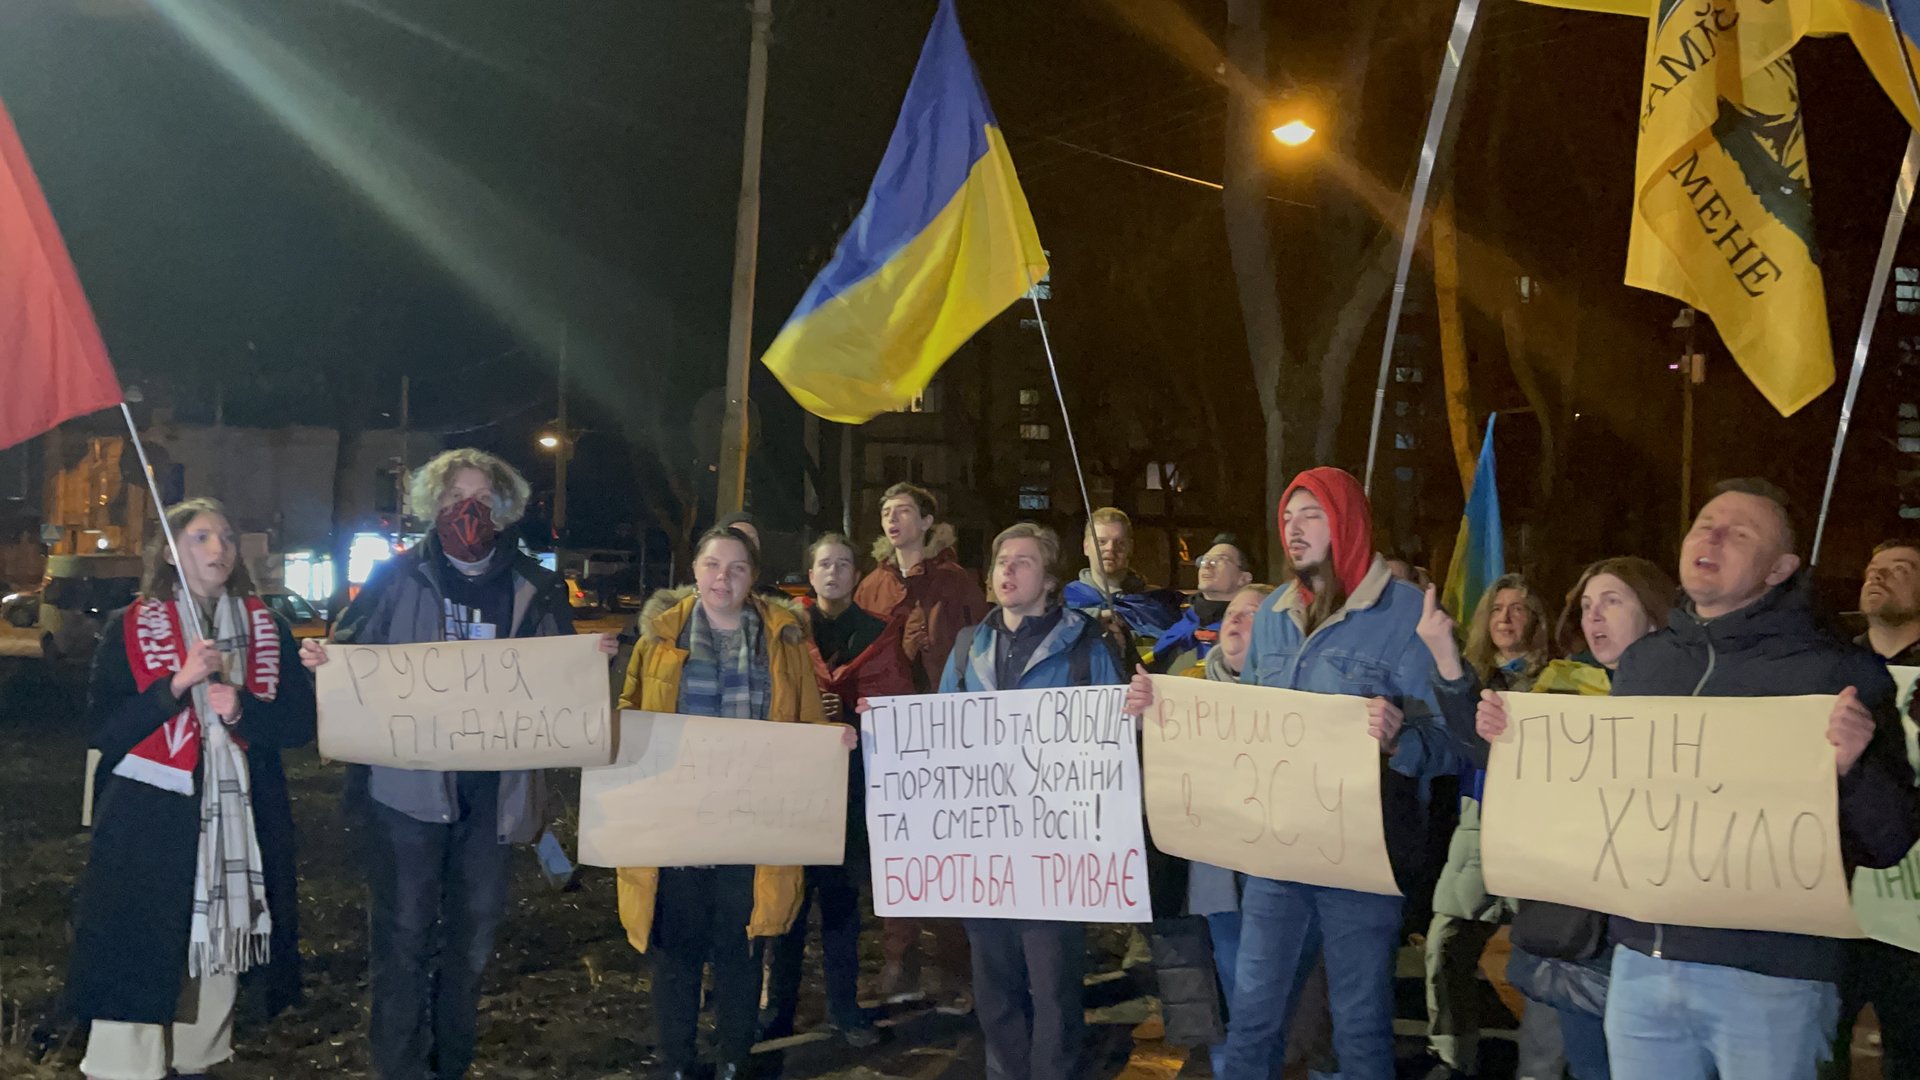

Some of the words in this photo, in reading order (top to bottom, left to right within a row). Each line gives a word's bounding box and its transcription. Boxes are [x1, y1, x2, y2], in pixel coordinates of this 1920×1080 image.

[1668, 149, 1783, 297] МЕНЕ
[388, 706, 606, 757] ПІДАРАСИ
[871, 696, 1006, 760] ГІДНІСТЬ
[1009, 713, 1034, 745] ТА
[1036, 687, 1134, 750] СВОБОДА
[1158, 695, 1306, 748] ВІРИМО
[1516, 711, 1707, 783] ПУТІН
[878, 812, 910, 842] ТА
[932, 804, 1023, 840] СМЕРТЬ
[1232, 752, 1346, 865] ЗСУ
[1592, 783, 1827, 890] ХУЙЛО
[885, 853, 1016, 906] БОРОТЬБА
[1032, 848, 1139, 909] ТРИВАЄ
